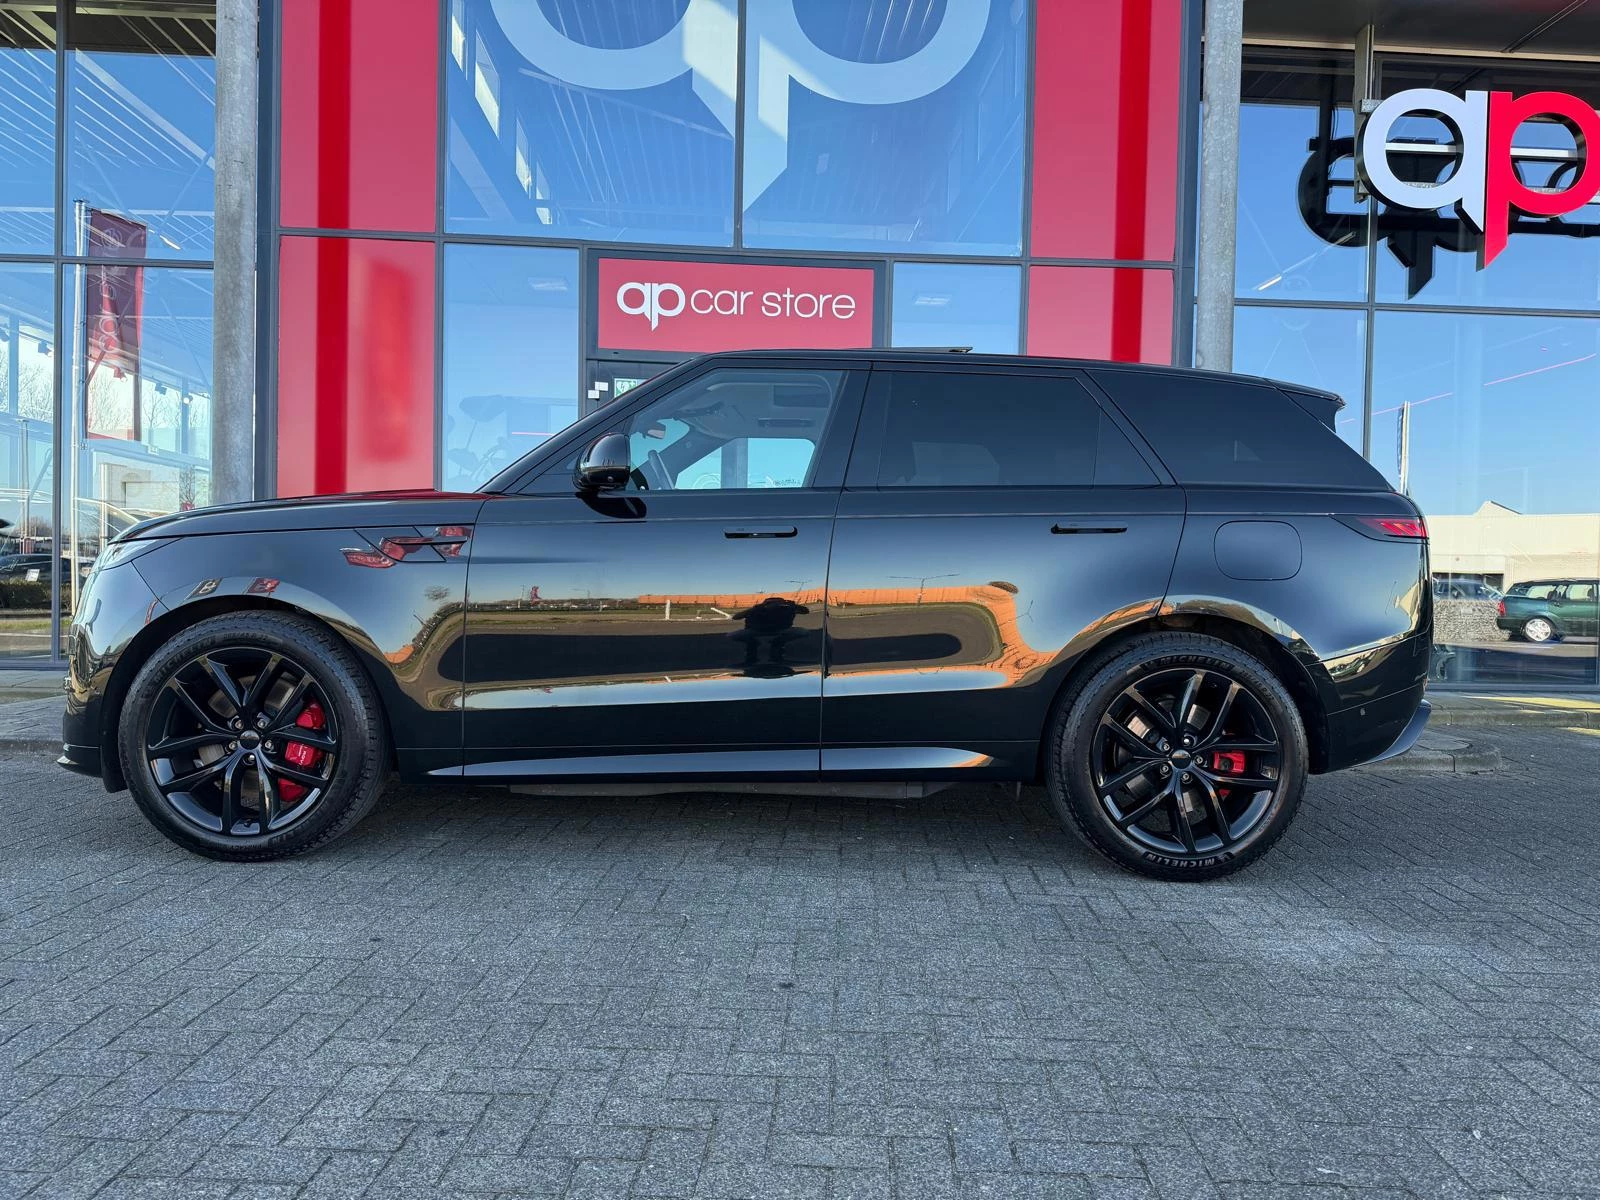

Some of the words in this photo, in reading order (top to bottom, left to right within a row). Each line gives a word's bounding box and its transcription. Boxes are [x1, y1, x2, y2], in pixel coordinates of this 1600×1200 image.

[690, 289, 754, 316] car
[761, 287, 856, 320] store
[1159, 654, 1234, 670] MICHELIN
[1146, 853, 1215, 868] MICHELIN
